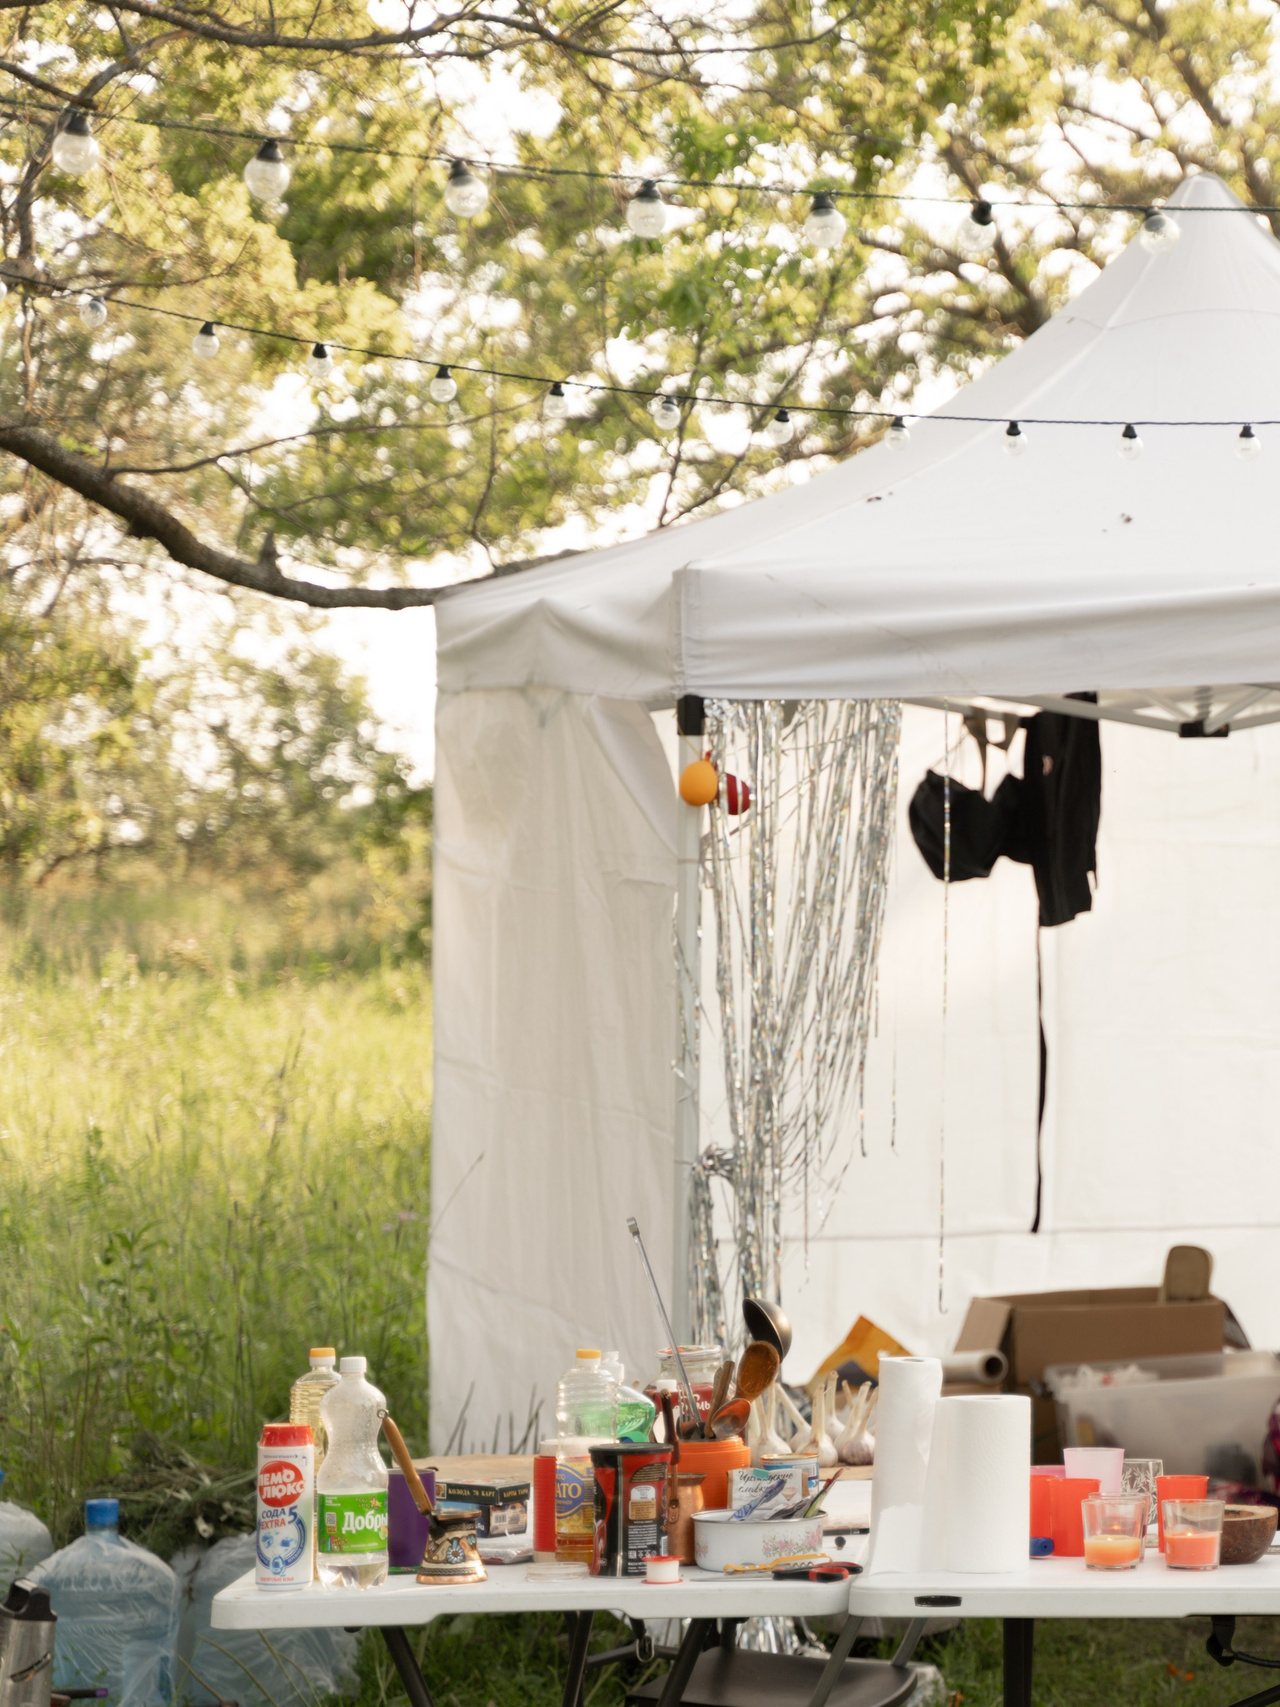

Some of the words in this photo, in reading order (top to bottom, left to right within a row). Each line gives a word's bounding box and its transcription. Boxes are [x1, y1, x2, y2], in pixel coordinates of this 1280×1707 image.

[262, 1480, 305, 1500] ЛЮКС
[261, 1508, 286, 1519] СОДА
[288, 1505, 298, 1525] 5
[261, 1518, 286, 1529] EXTRA
